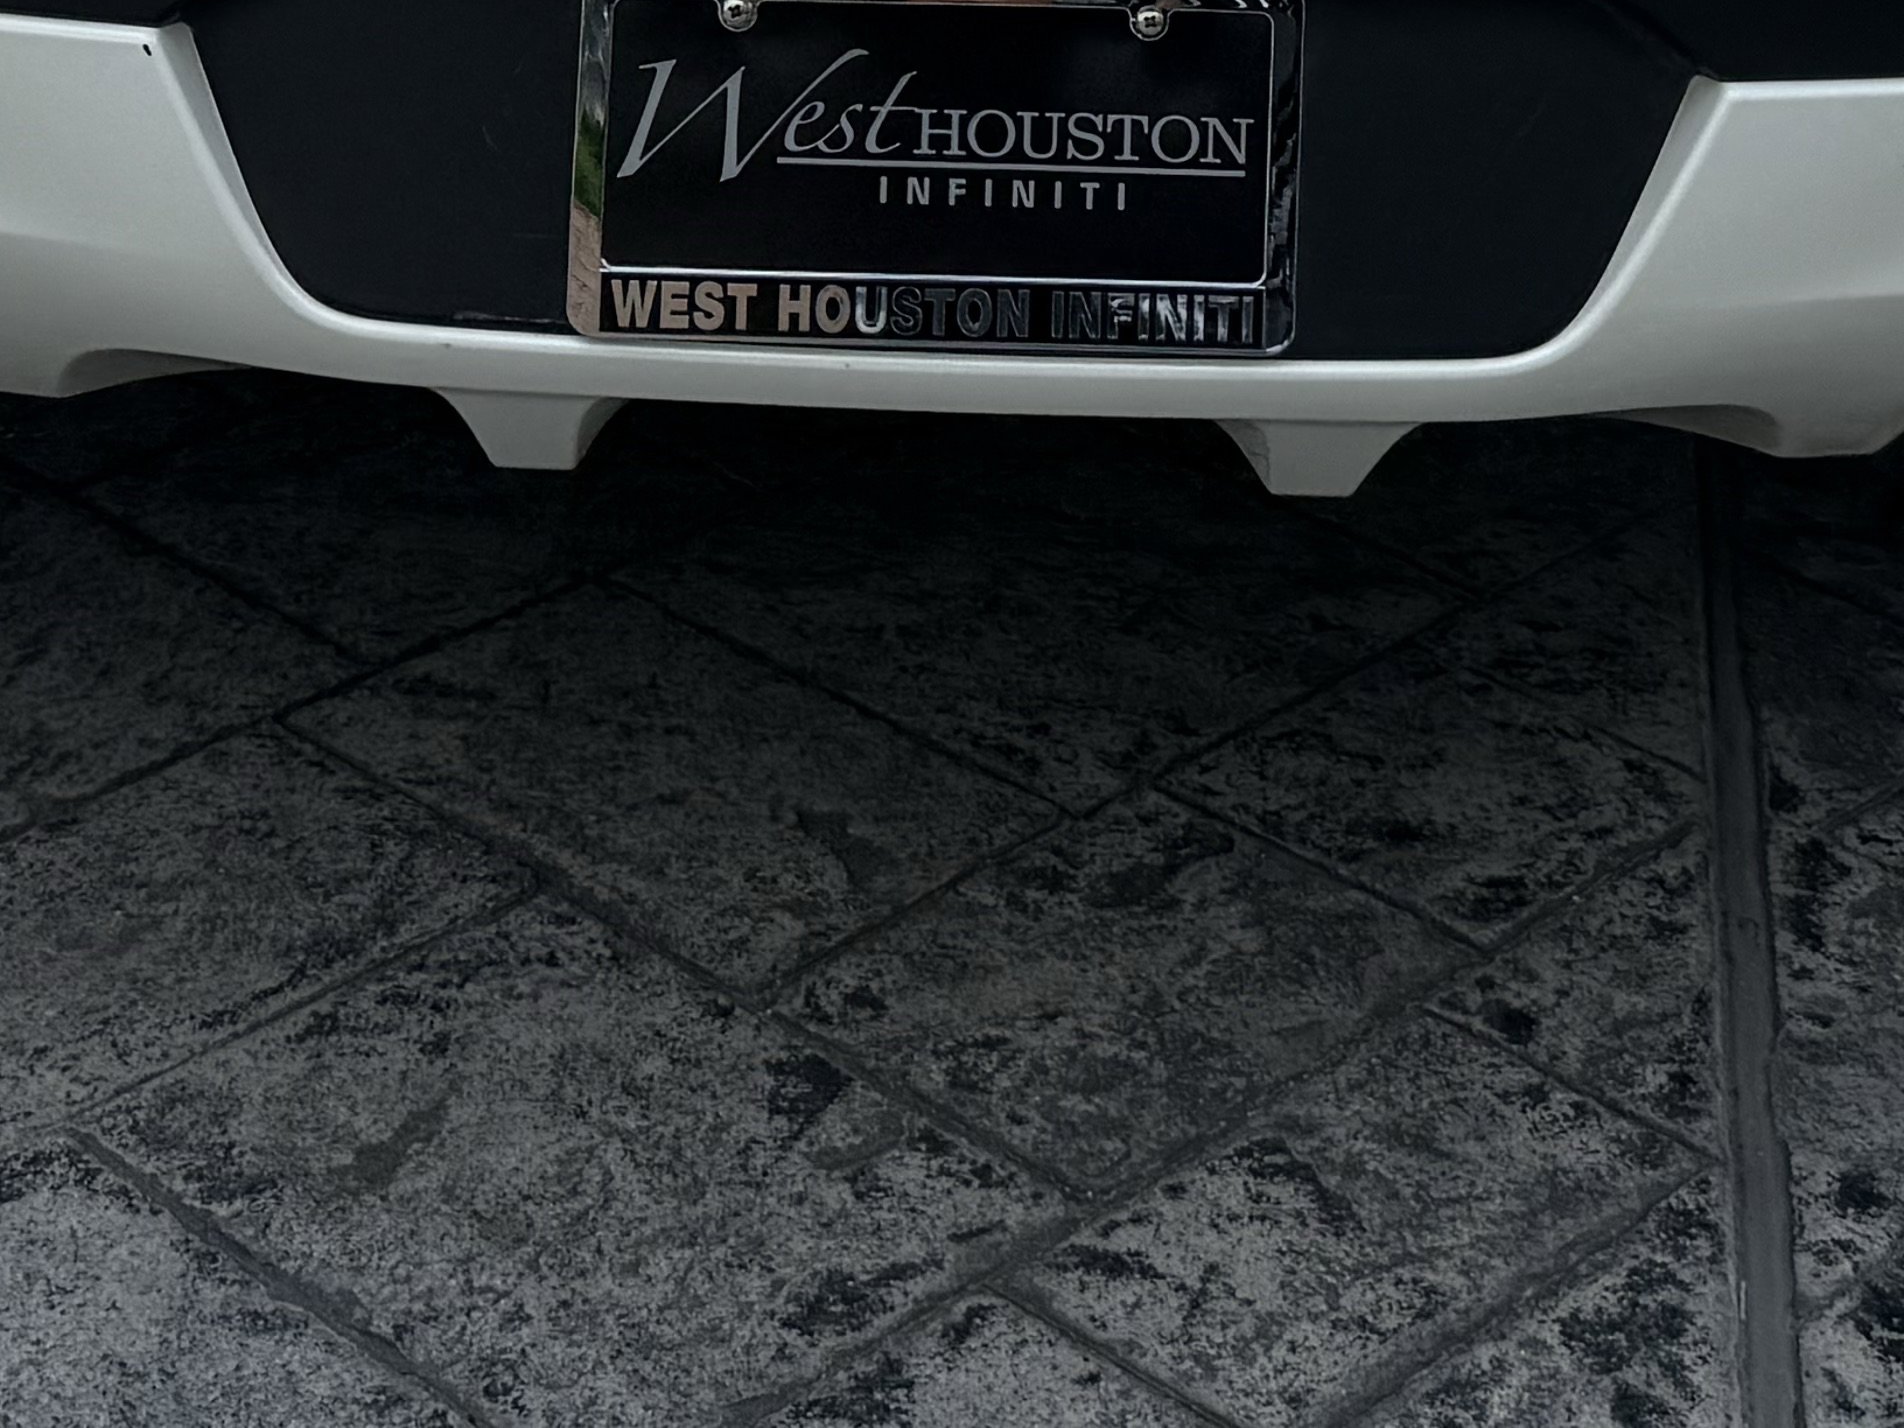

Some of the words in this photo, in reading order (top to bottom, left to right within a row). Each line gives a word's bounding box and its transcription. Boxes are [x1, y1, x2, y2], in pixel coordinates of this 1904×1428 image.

[615, 47, 918, 183] West
[915, 107, 1255, 165] HOUSTON
[878, 174, 1128, 211] INFINITI
[611, 278, 758, 331] WEST
[777, 282, 1030, 339] HOUSTON
[1050, 289, 1255, 345] INFINITI
